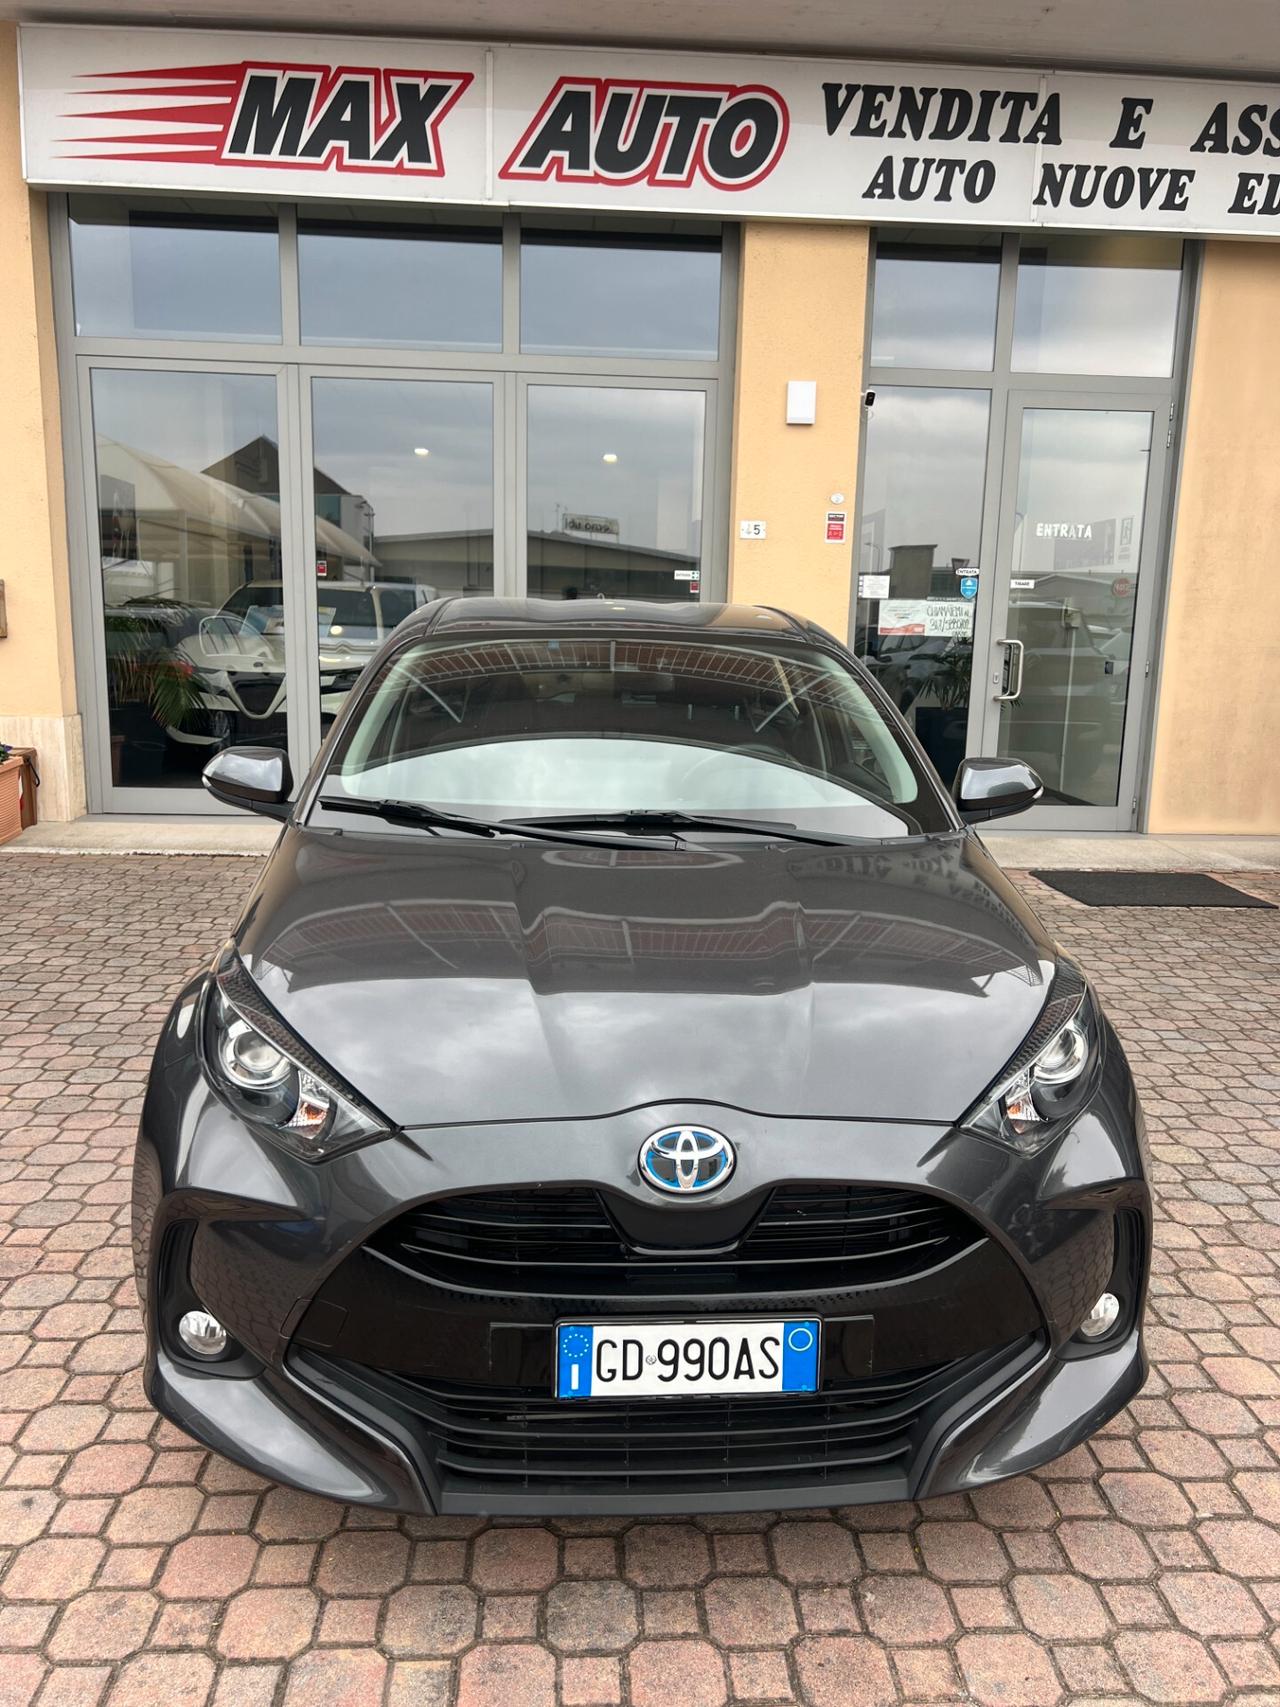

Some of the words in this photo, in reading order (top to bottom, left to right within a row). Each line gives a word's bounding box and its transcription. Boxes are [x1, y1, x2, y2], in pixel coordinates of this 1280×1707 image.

[227, 73, 454, 165] MAX
[518, 88, 781, 180] AUTO
[822, 83, 1062, 146] VENDITA
[1110, 97, 1153, 150] E
[862, 156, 996, 203] AUTO
[1033, 163, 1195, 212] NUOVE
[1036, 523, 1092, 538] ENTRATA
